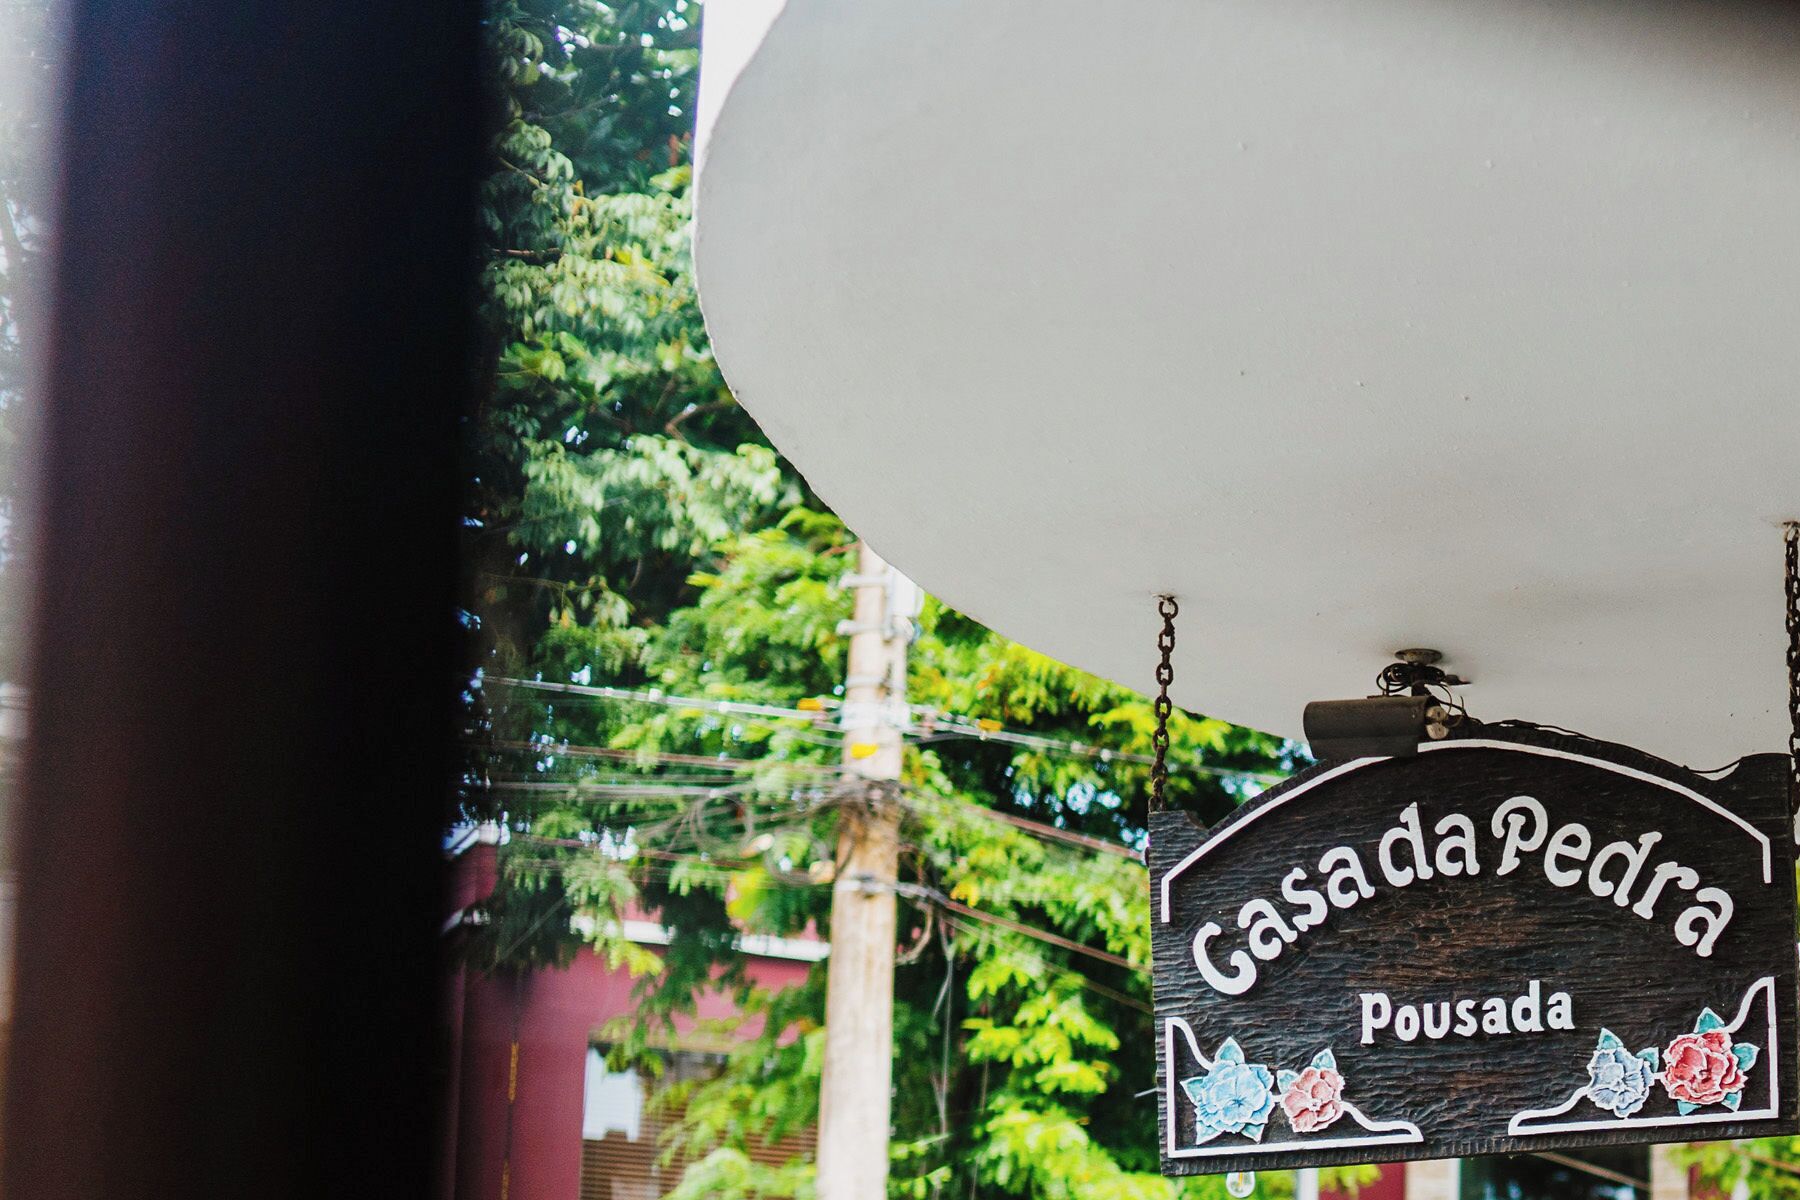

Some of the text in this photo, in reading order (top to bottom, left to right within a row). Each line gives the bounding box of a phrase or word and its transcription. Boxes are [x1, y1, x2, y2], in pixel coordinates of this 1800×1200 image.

[1192, 794, 1734, 996] Casa da Pedra
[1358, 979, 1576, 1046] Pousada
